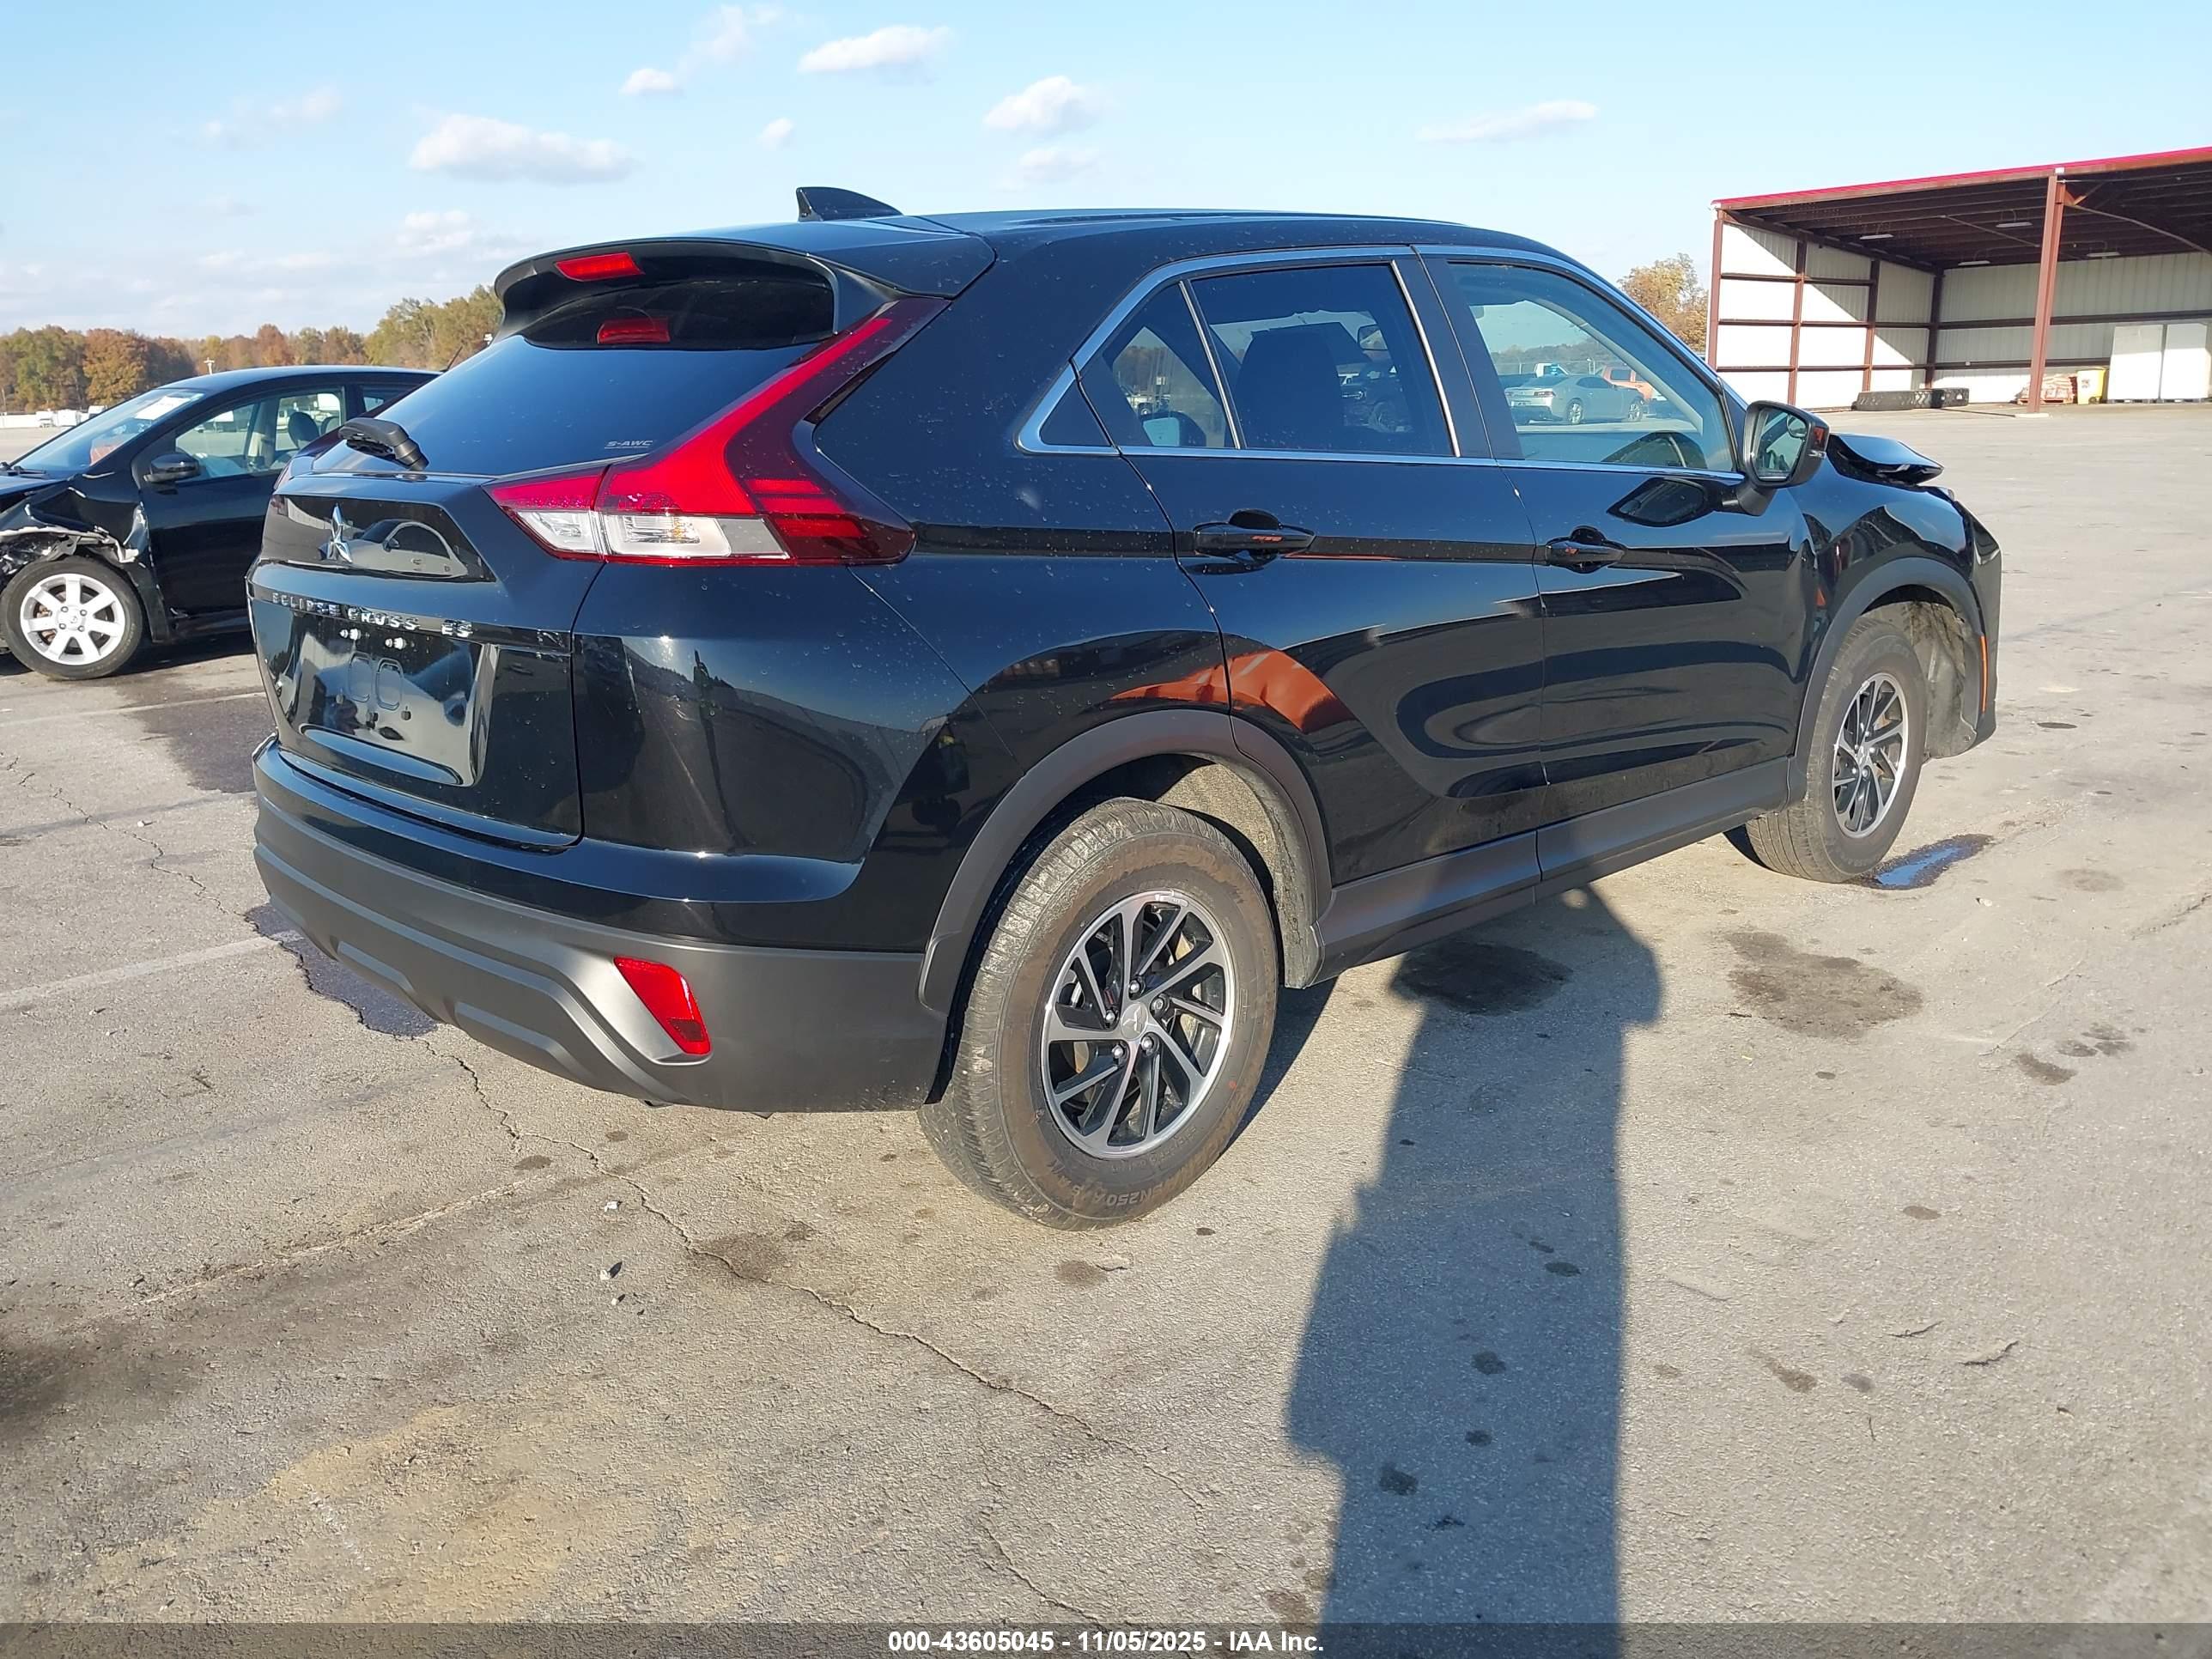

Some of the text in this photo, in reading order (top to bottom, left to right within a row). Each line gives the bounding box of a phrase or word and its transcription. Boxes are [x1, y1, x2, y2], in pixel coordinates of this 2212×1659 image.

[271, 592, 474, 638] ECLIPSE CROSS ES
